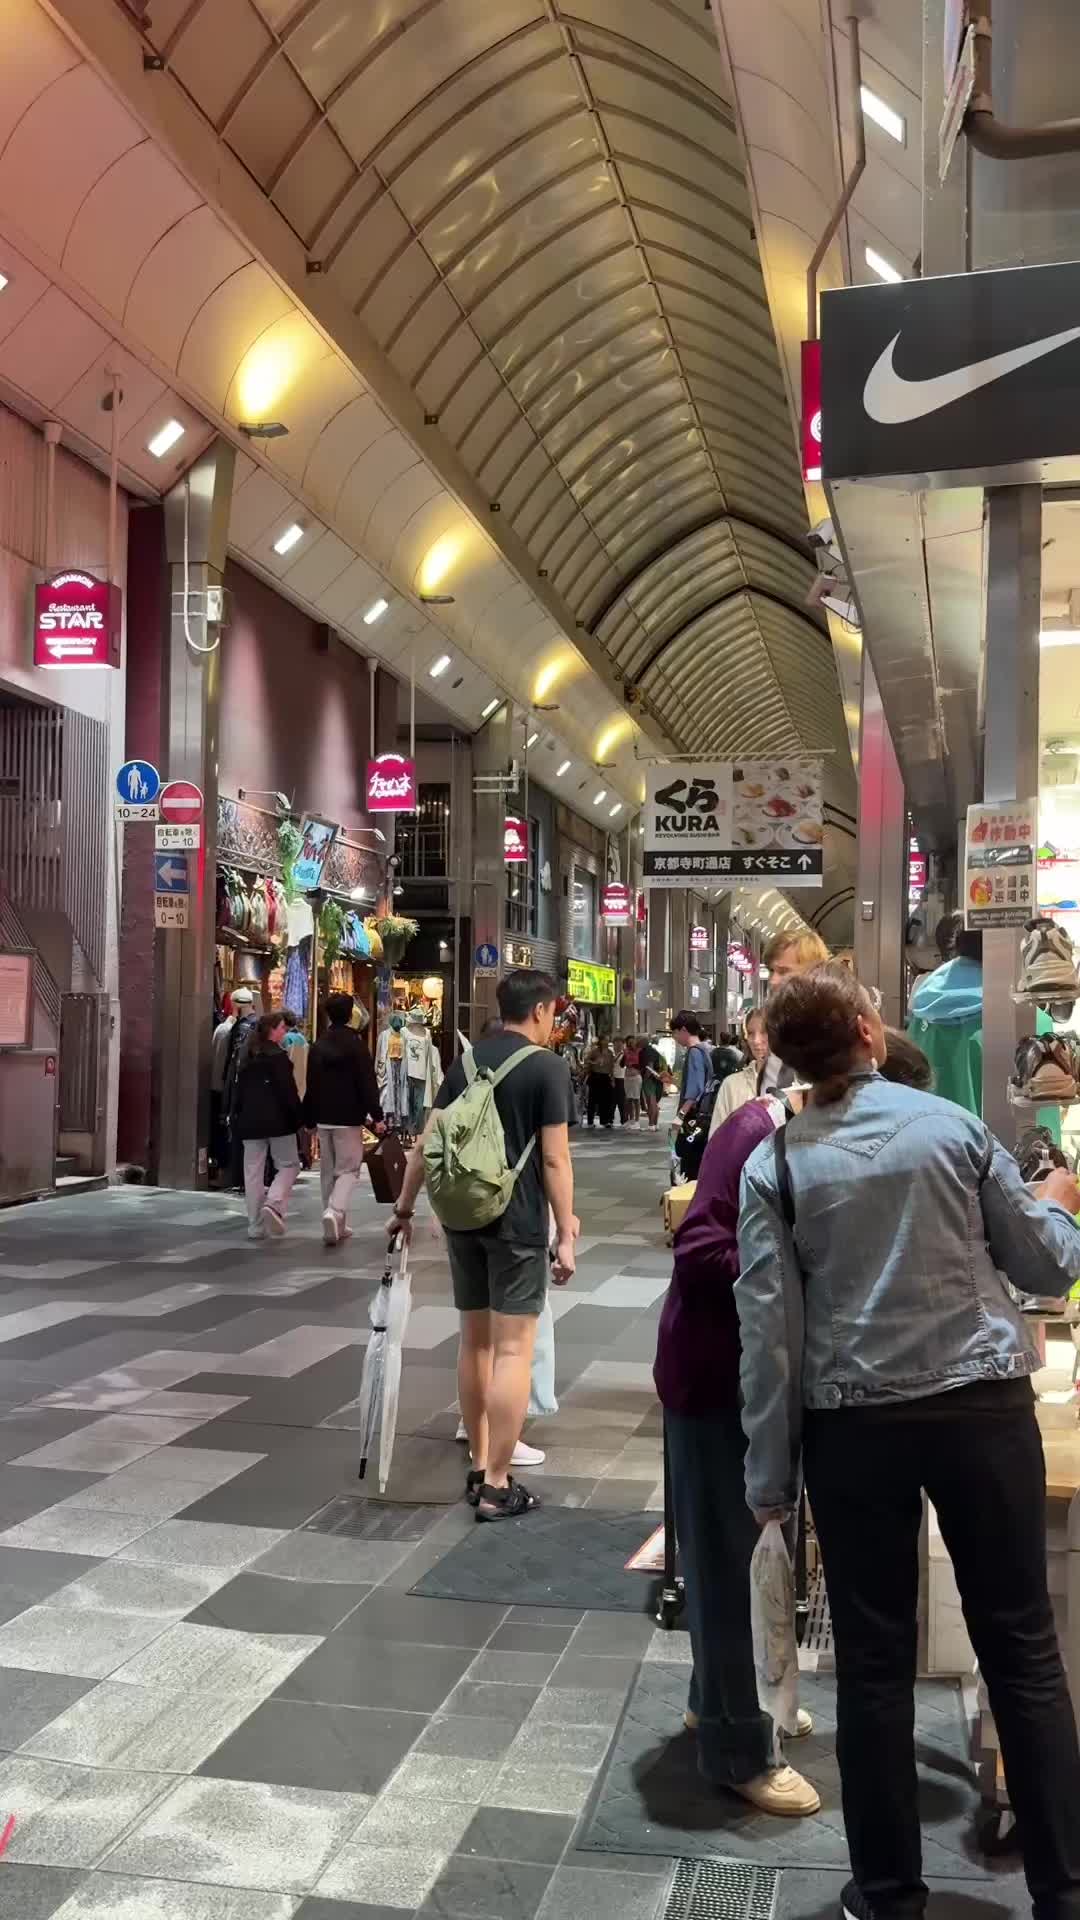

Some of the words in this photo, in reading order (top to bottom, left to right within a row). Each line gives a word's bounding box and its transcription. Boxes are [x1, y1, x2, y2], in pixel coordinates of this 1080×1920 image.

[48, 603, 96, 612] Restaurant
[39, 612, 104, 630] STAR
[654, 778, 720, 814] くら
[655, 815, 720, 832] KURA
[654, 856, 732, 870] 京都寺町通店
[742, 855, 791, 870] すぐそこ
